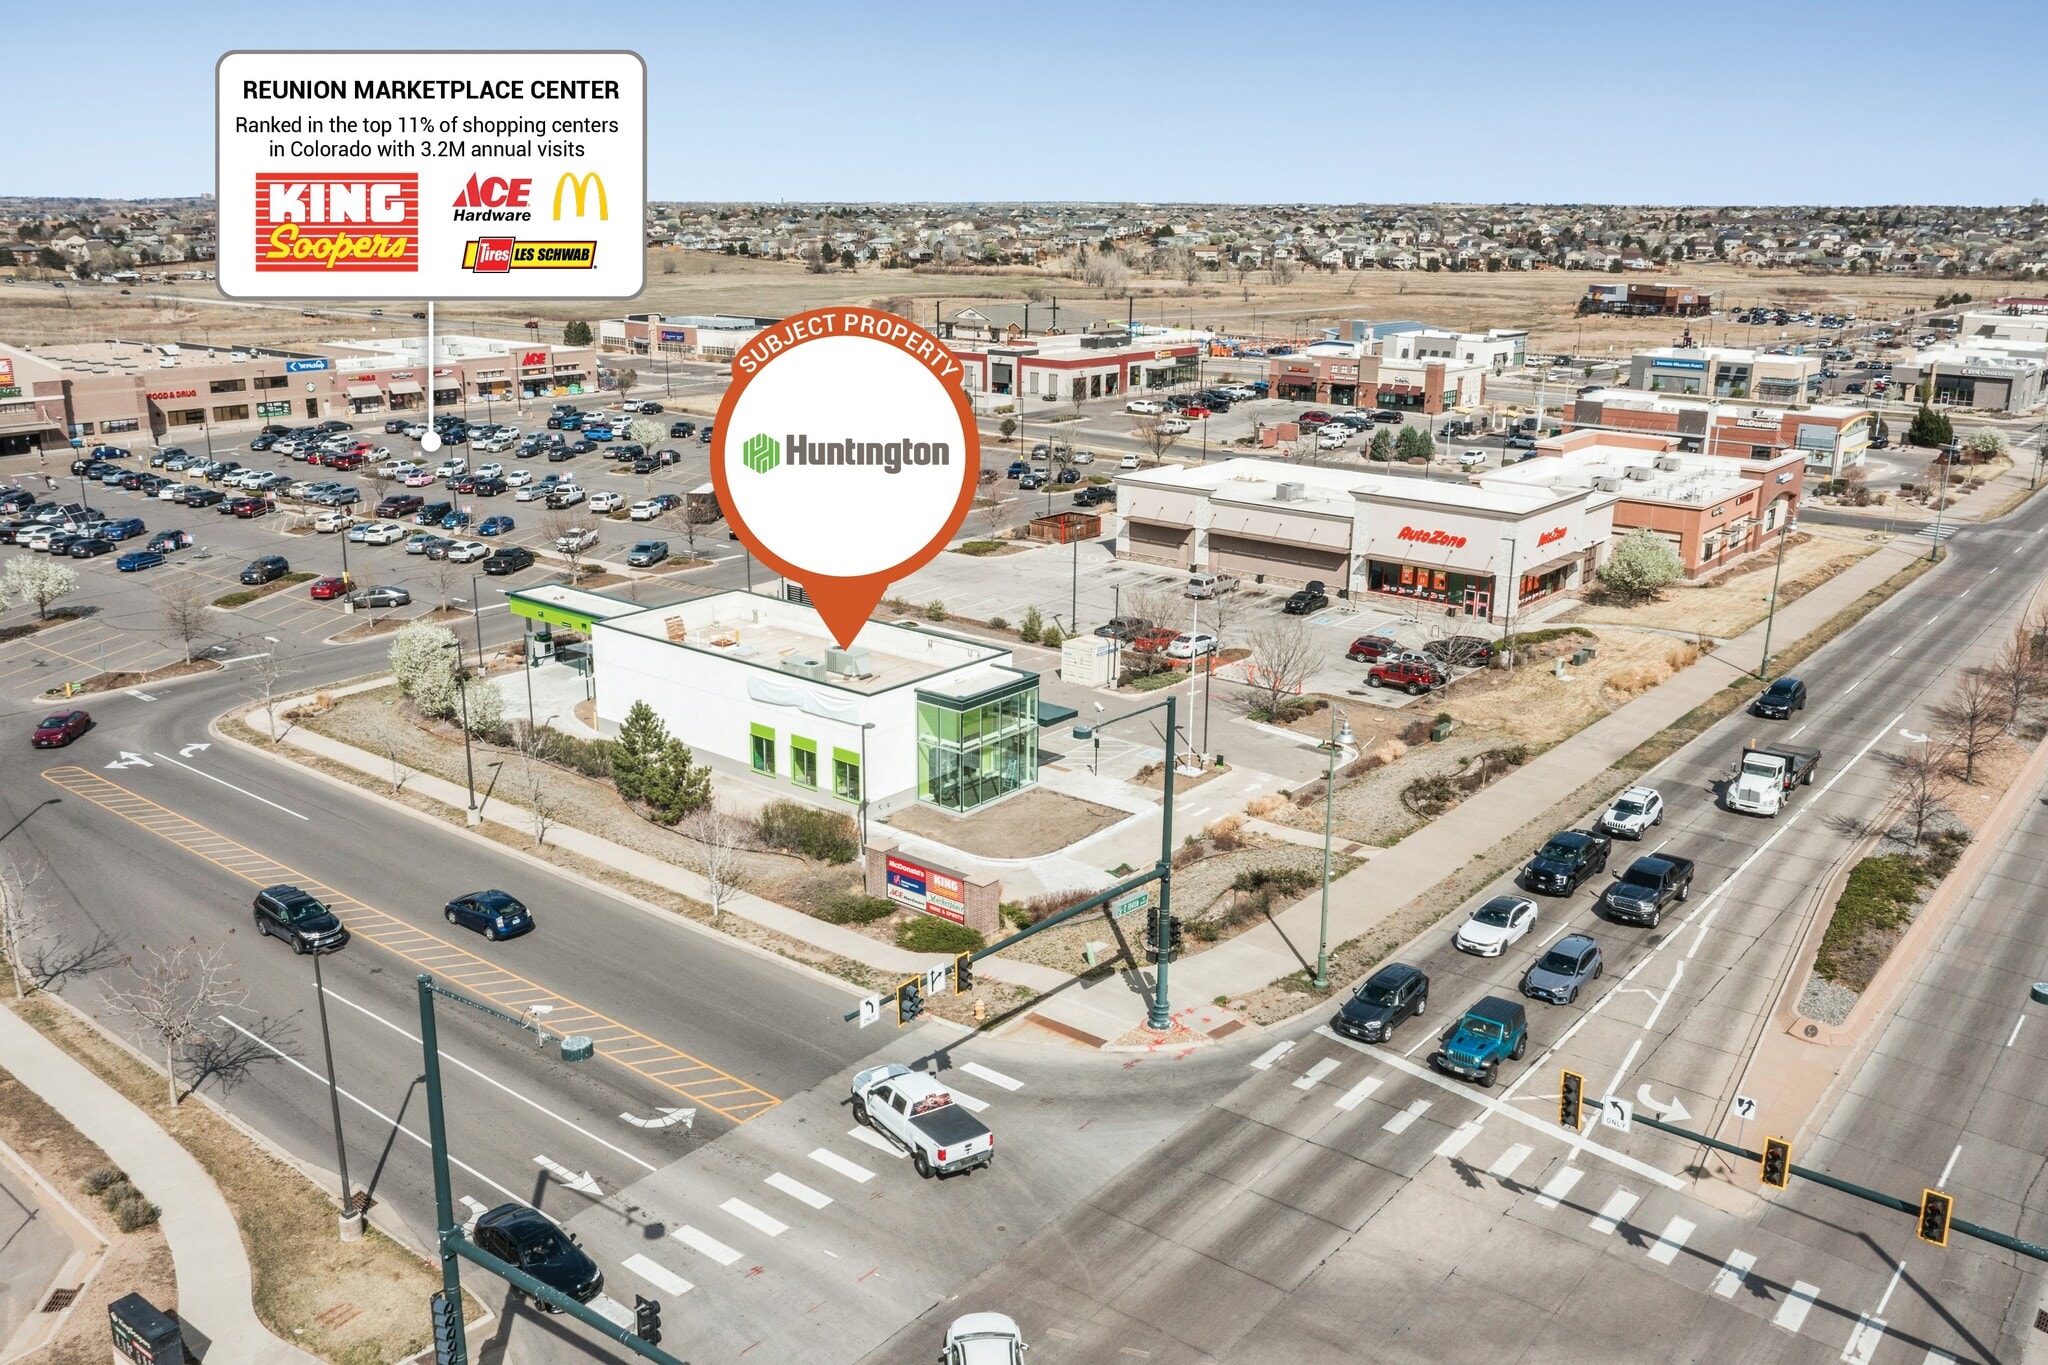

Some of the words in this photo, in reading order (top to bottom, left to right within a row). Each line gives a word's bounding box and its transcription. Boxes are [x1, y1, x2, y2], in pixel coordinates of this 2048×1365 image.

[522, 352, 546, 366] ACE
[888, 860, 925, 878] McDonald's
[934, 874, 958, 892] KING
[889, 889, 904, 899] ACE
[1606, 1117, 1626, 1129] ONLY
